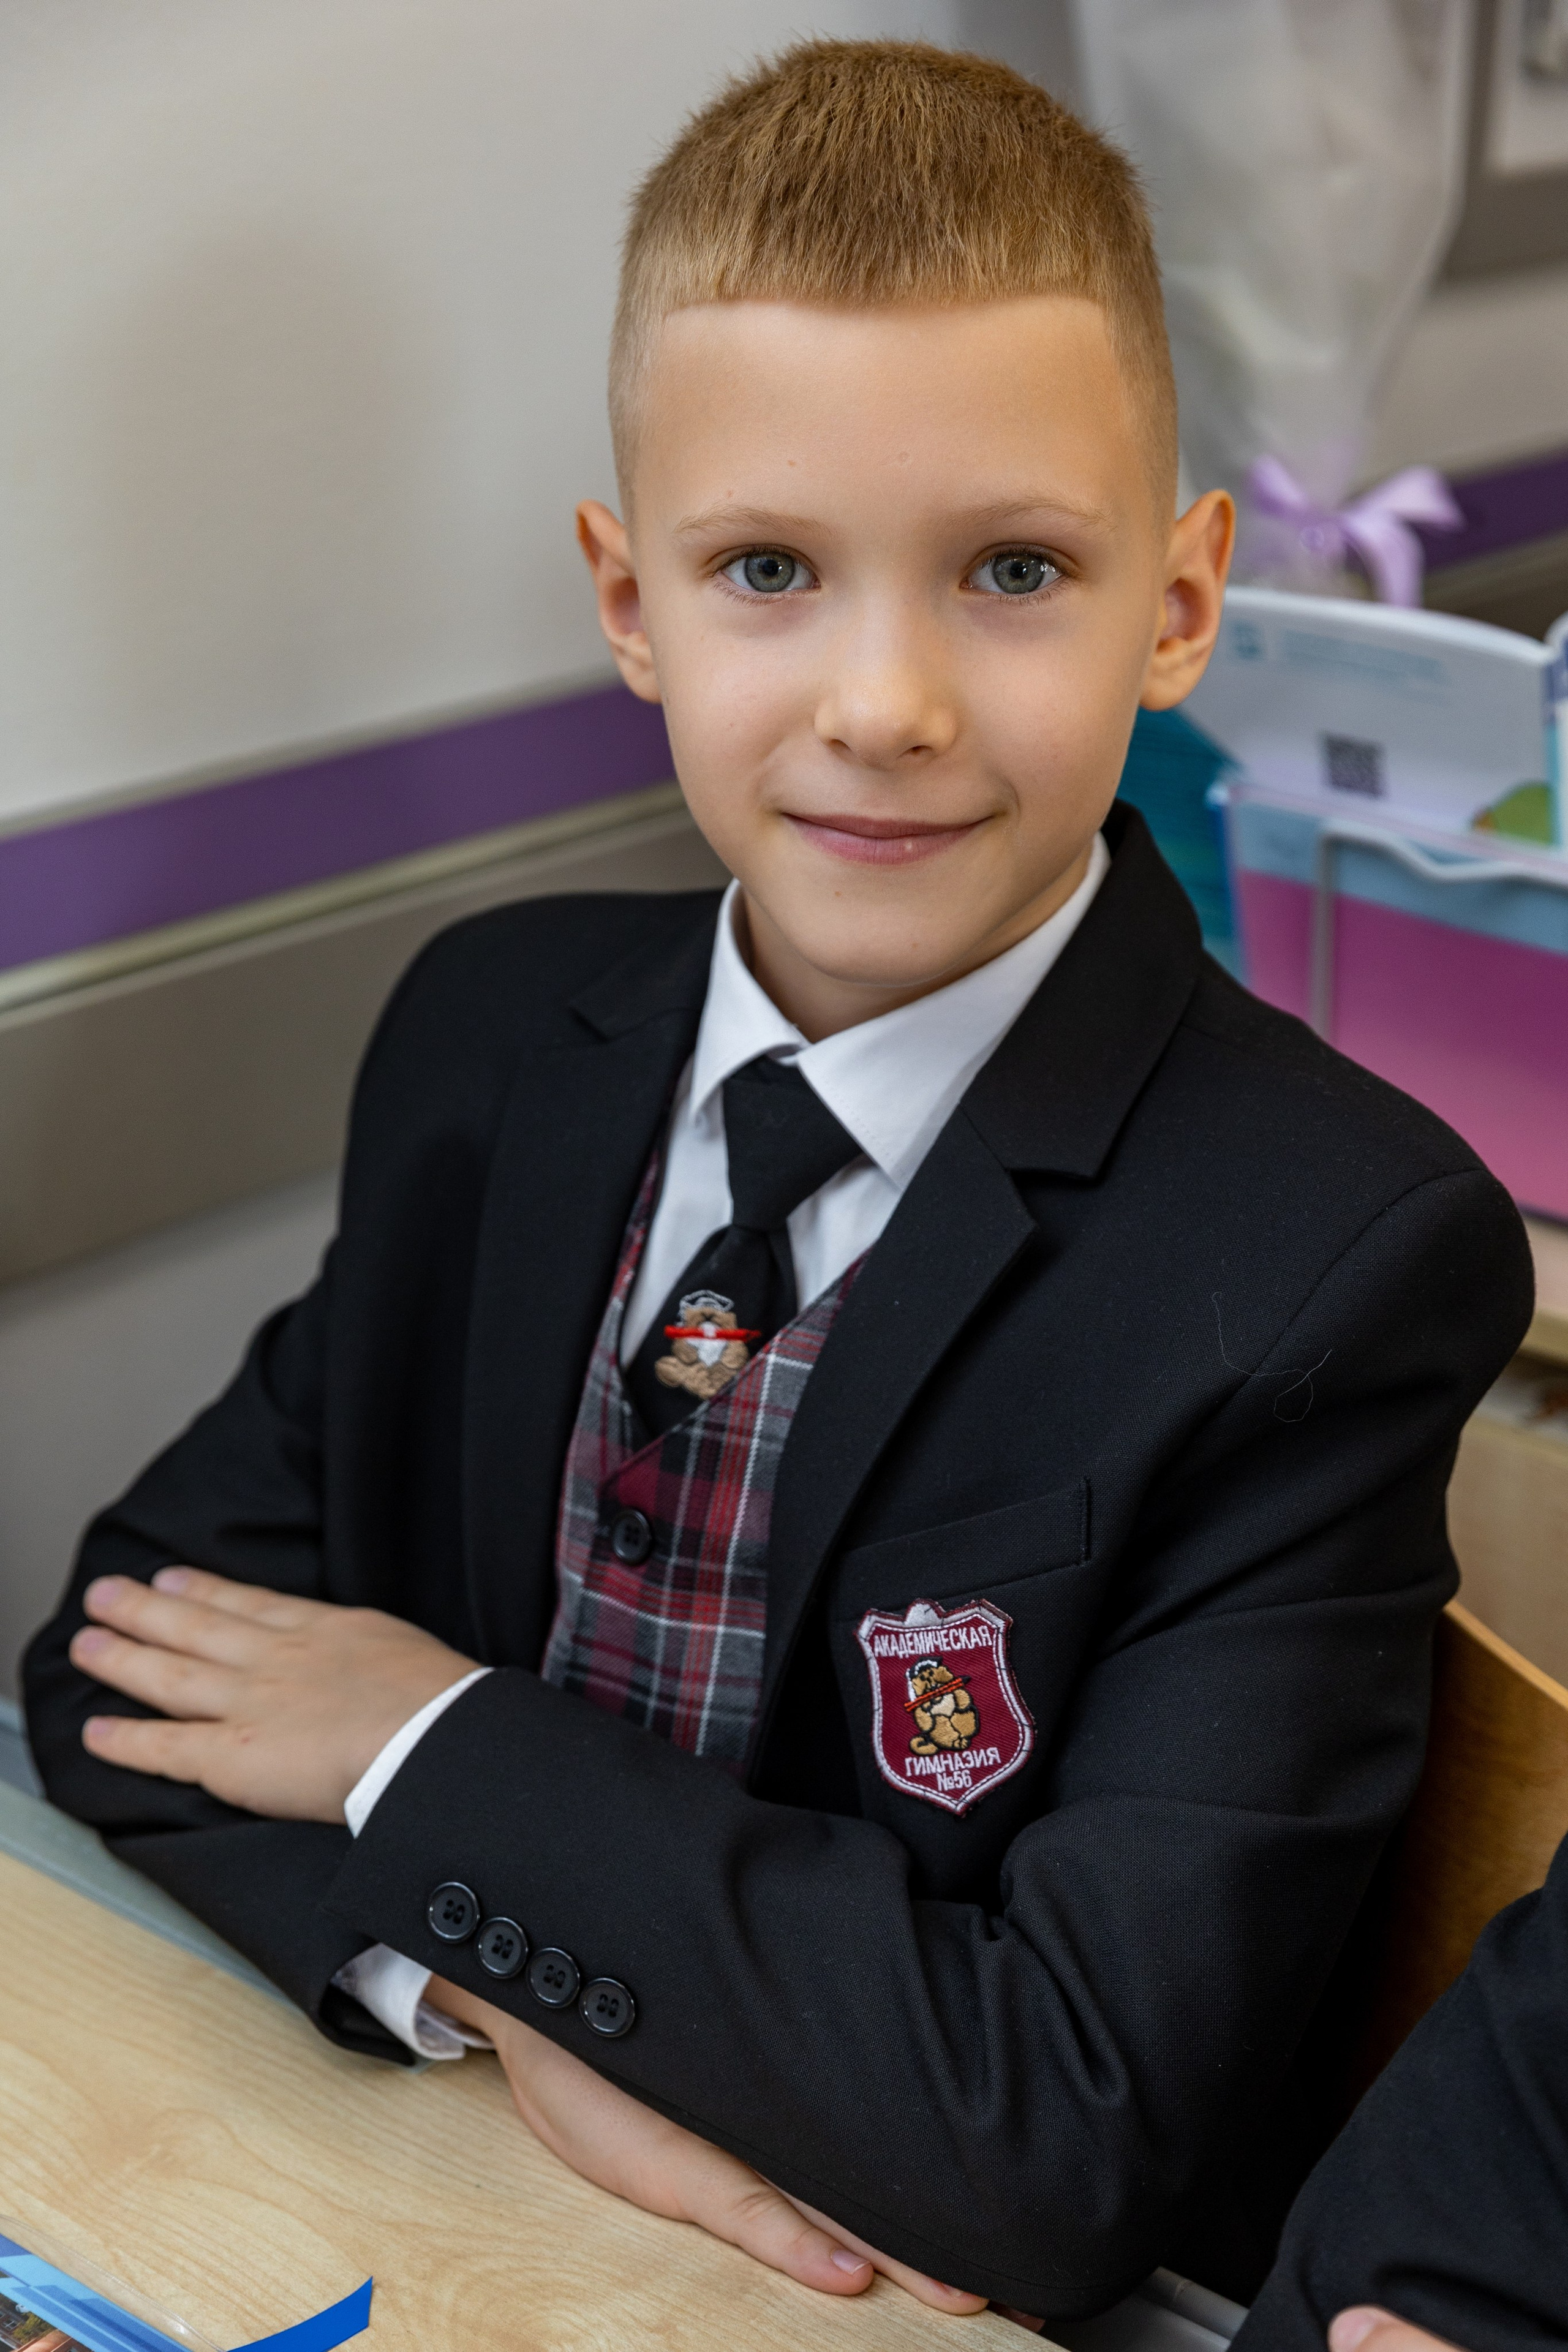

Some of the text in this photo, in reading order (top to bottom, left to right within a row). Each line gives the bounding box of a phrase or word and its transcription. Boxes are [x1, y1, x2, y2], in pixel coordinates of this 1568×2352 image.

[874, 1626, 992, 1658] АКАДЕМИЧЕСКАЯ
[905, 1747, 1001, 1776] ГИМНАЗИЯ
[937, 1770, 973, 1792] №56
